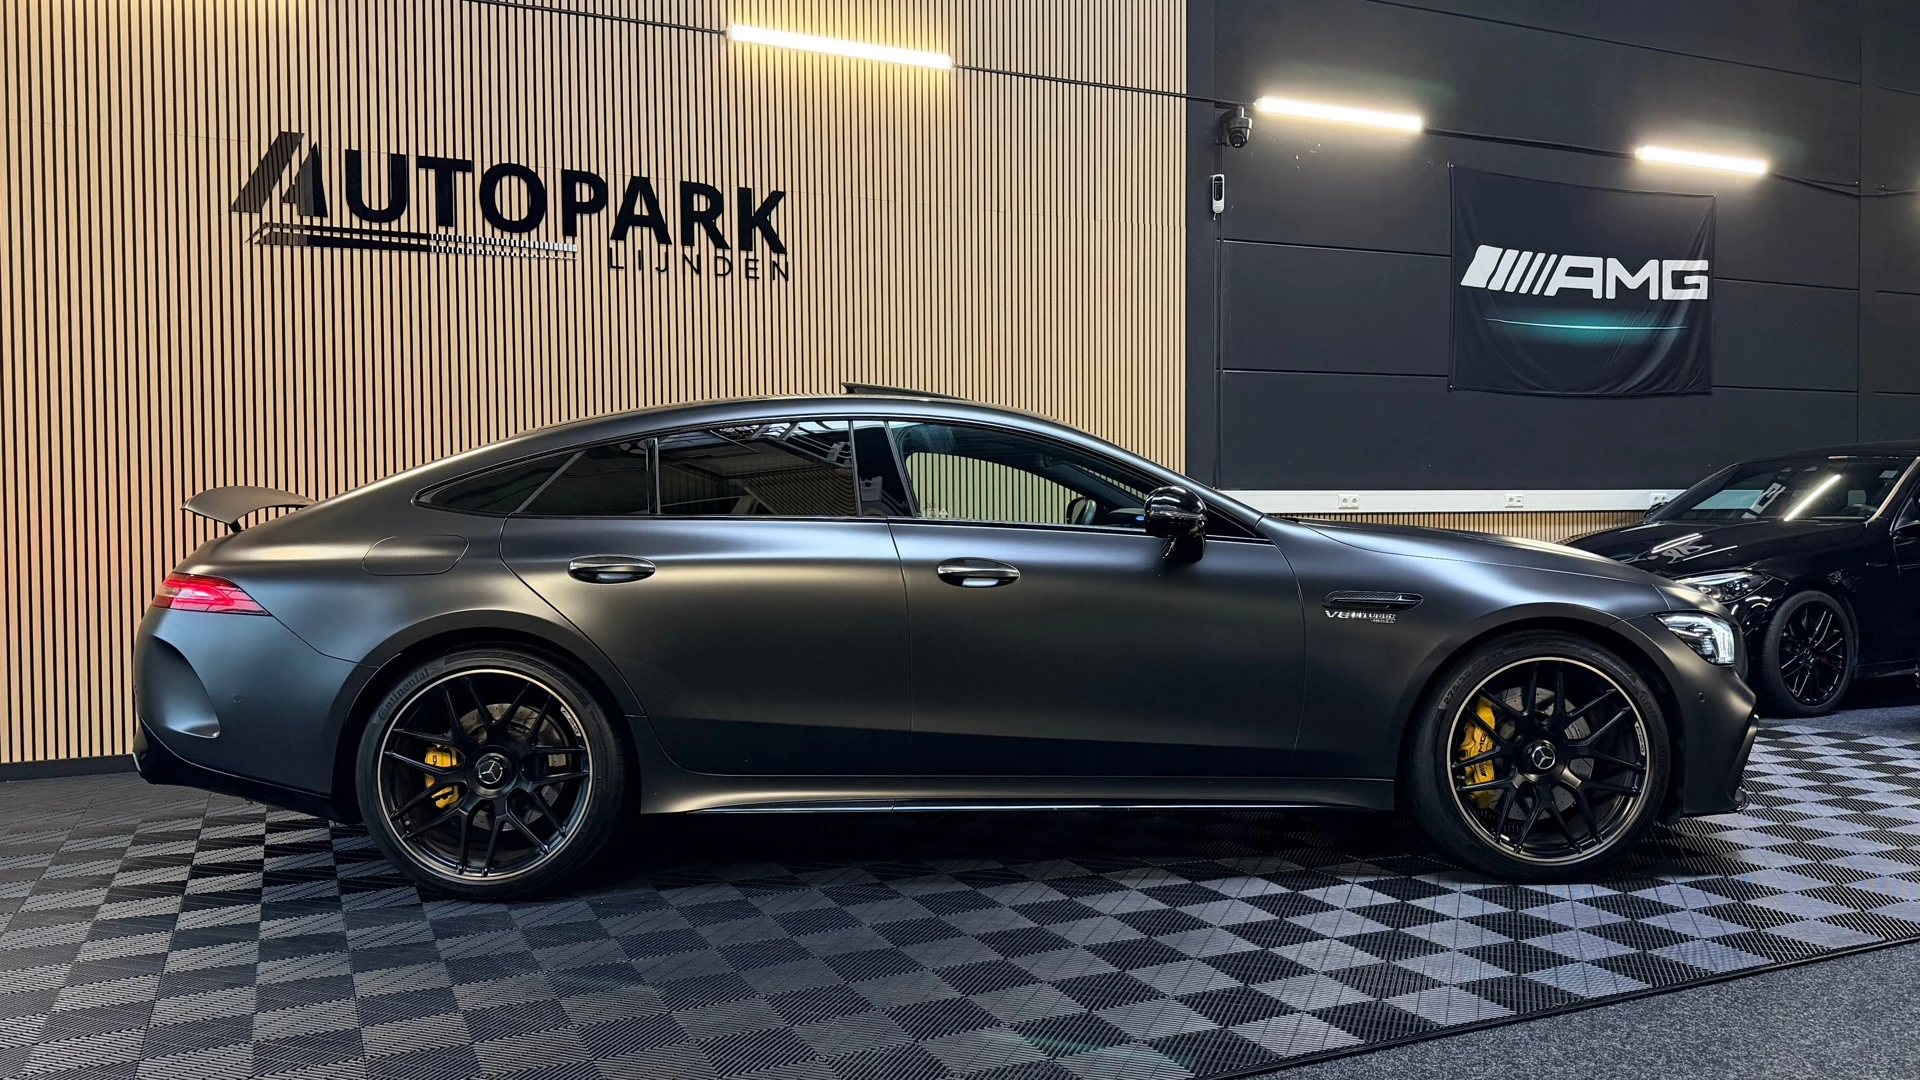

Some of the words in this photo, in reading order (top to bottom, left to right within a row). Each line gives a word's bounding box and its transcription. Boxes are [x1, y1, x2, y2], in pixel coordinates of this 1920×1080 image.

[231, 131, 788, 254] AUTOPARK
[609, 247, 789, 281] LIJNDEN
[378, 667, 430, 720] Continental
